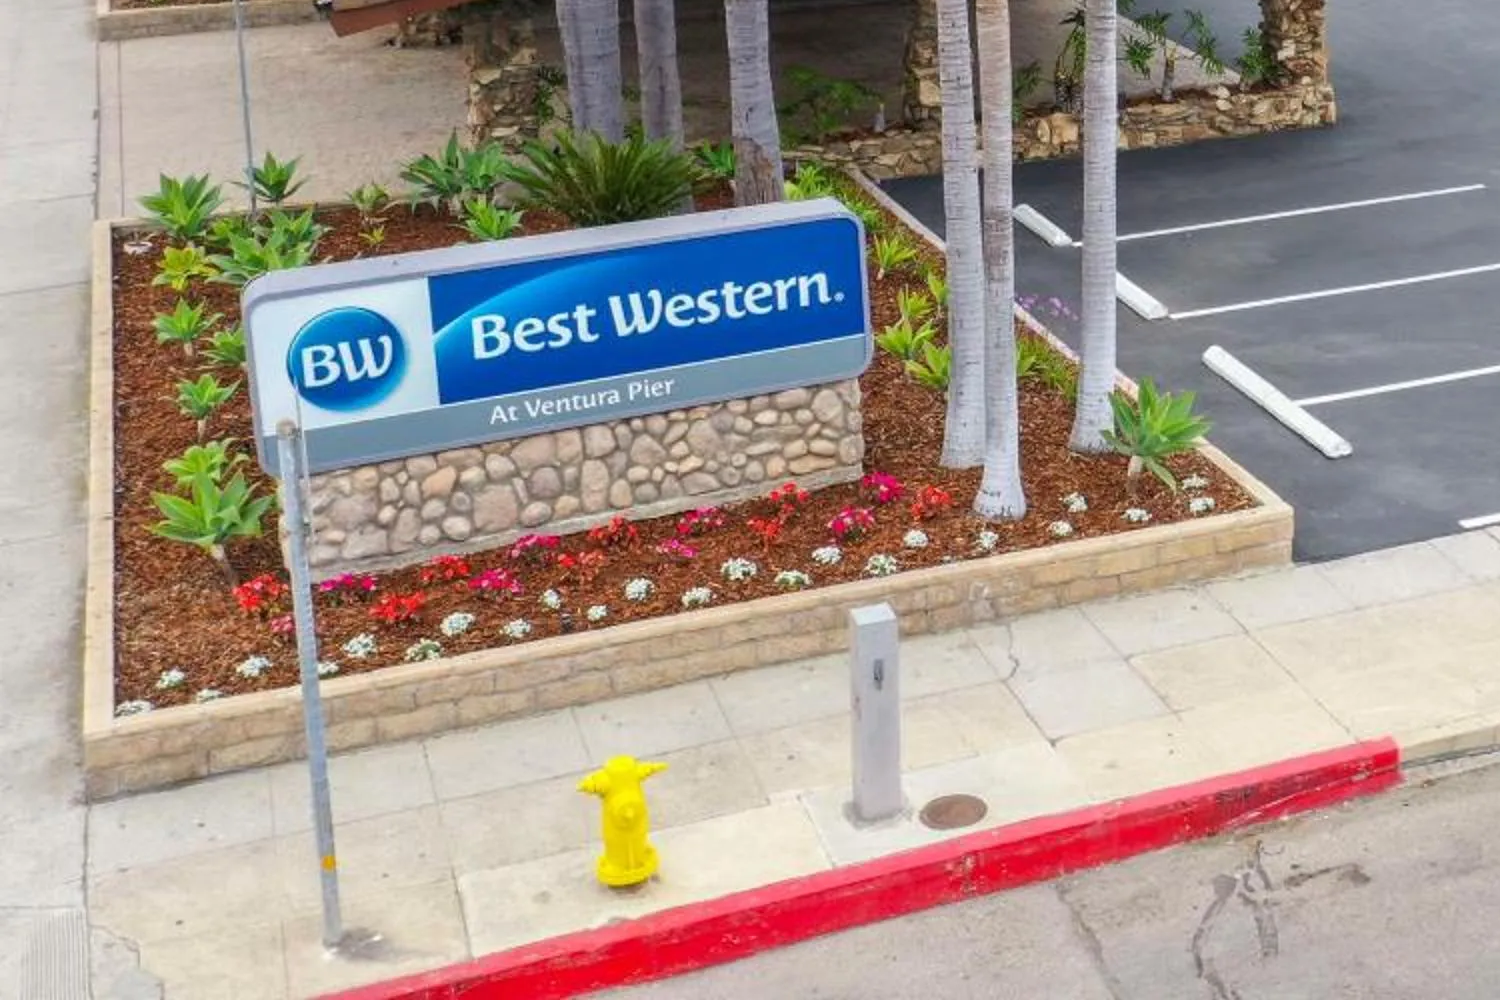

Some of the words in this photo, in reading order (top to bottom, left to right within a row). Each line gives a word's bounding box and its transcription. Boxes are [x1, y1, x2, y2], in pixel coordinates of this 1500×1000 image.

[471, 303, 599, 361] Best
[300, 334, 393, 388] BW
[489, 404, 518, 426] At
[523, 388, 622, 419] Ventura
[627, 377, 677, 402] Pier
